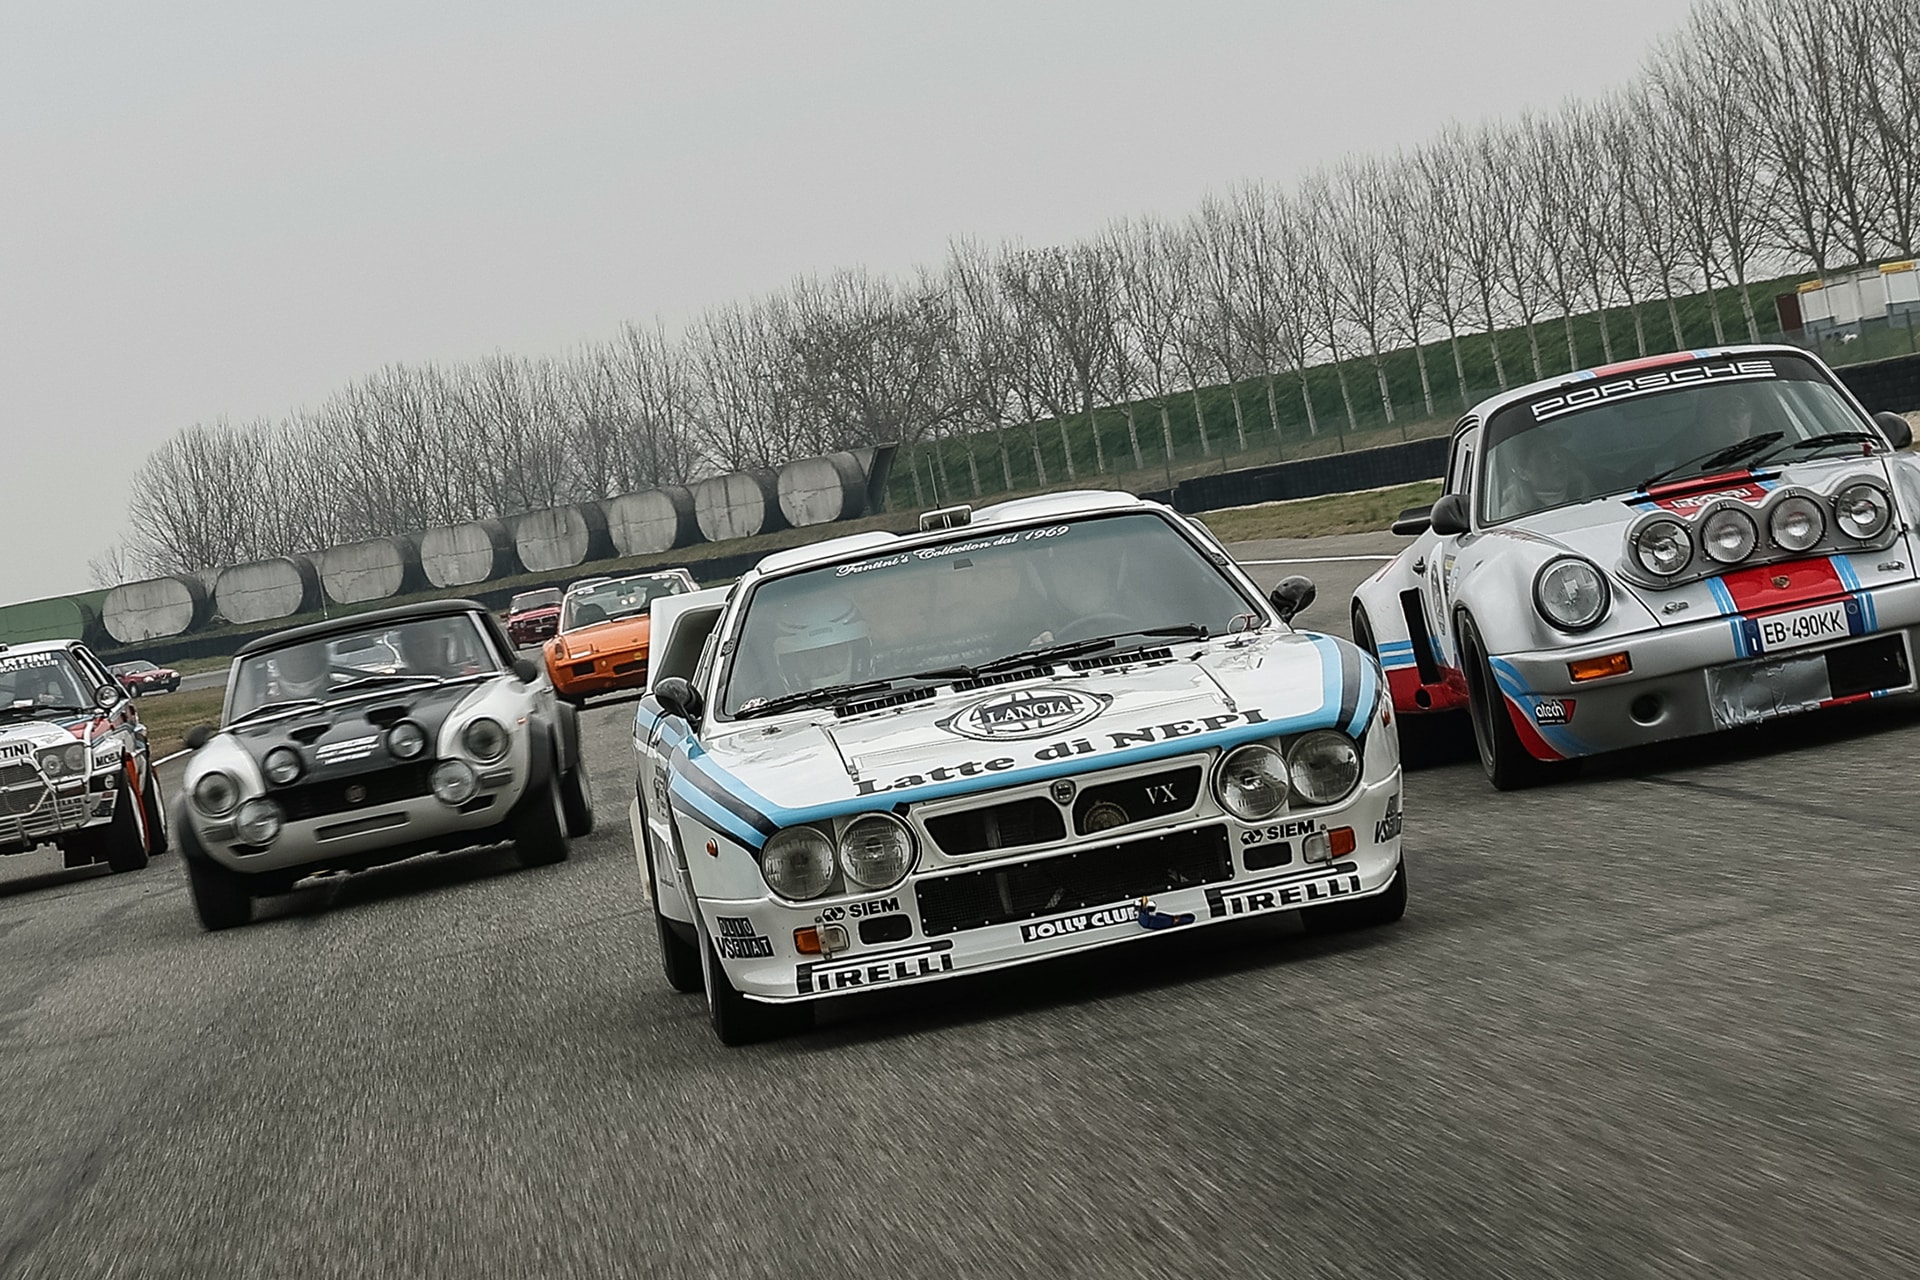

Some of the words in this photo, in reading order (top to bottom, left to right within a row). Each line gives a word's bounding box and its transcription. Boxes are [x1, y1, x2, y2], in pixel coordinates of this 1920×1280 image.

[1530, 360, 1775, 419] PORSCHE
[835, 554, 909, 578] Fantini's
[913, 541, 992, 561] Collection
[992, 534, 1018, 547] dal
[1024, 525, 1070, 541] 1969
[986, 699, 1072, 725] LANCIA
[0, 743, 29, 759] TINI
[855, 756, 1015, 797] Latte
[1034, 737, 1097, 762] di
[1111, 708, 1271, 750] NEPI
[1144, 782, 1179, 805] VX
[1267, 819, 1316, 841] SIEM
[1204, 861, 1361, 918] PIRELLI
[848, 897, 900, 918] SIEM
[719, 919, 754, 936] OLIO
[1028, 916, 1088, 941] JOLLY
[796, 940, 955, 994] PIRELLI
